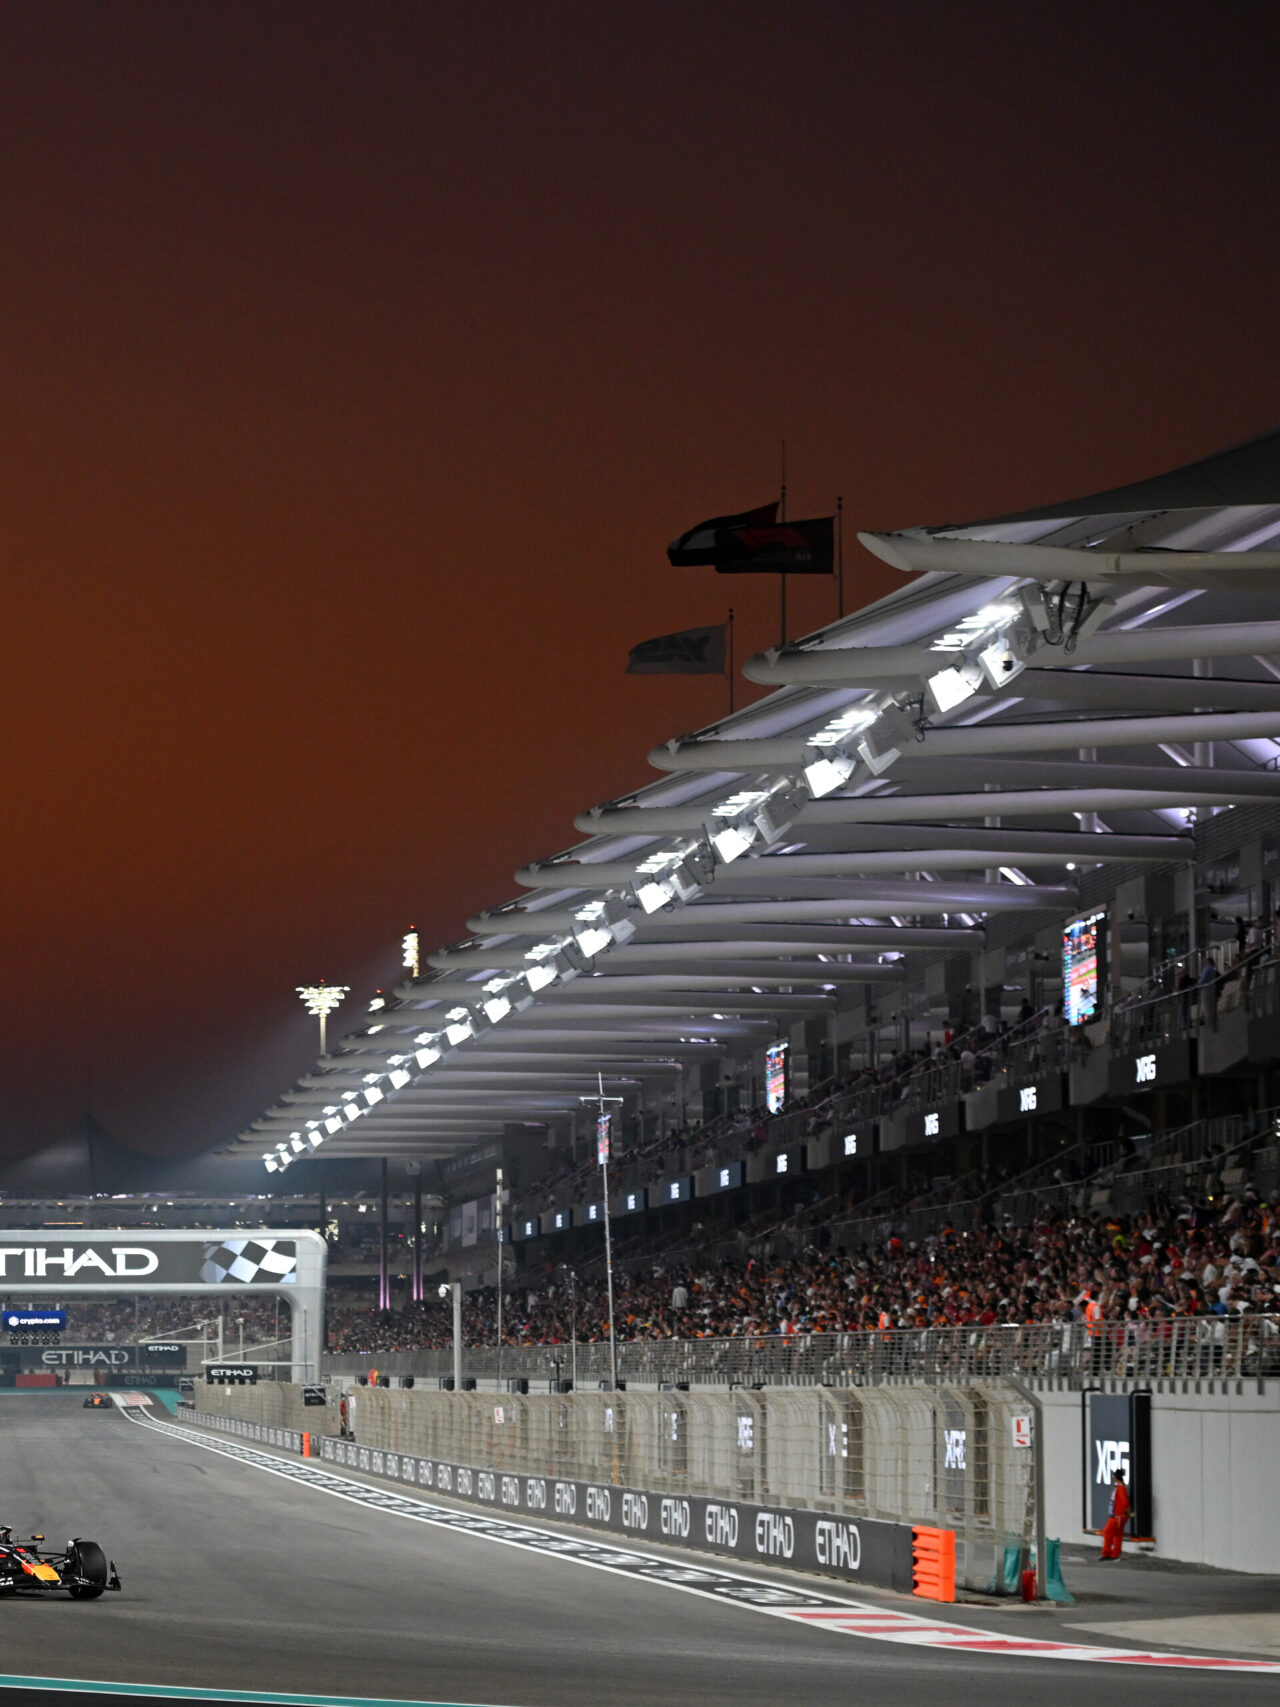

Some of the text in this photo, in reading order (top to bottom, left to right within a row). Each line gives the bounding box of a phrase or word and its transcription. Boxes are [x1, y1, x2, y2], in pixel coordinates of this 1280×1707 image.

[1135, 1054, 1156, 1083] XRG
[42, 1350, 129, 1365] ETIHAD
[586, 1487, 611, 1522] ETIHAD
[622, 1493, 648, 1530] ETIHAD
[661, 1498, 690, 1538] ETIHAD
[705, 1504, 738, 1548] ETIHAD
[755, 1512, 794, 1558] ETIHAD
[815, 1520, 861, 1570] ETIHAD
